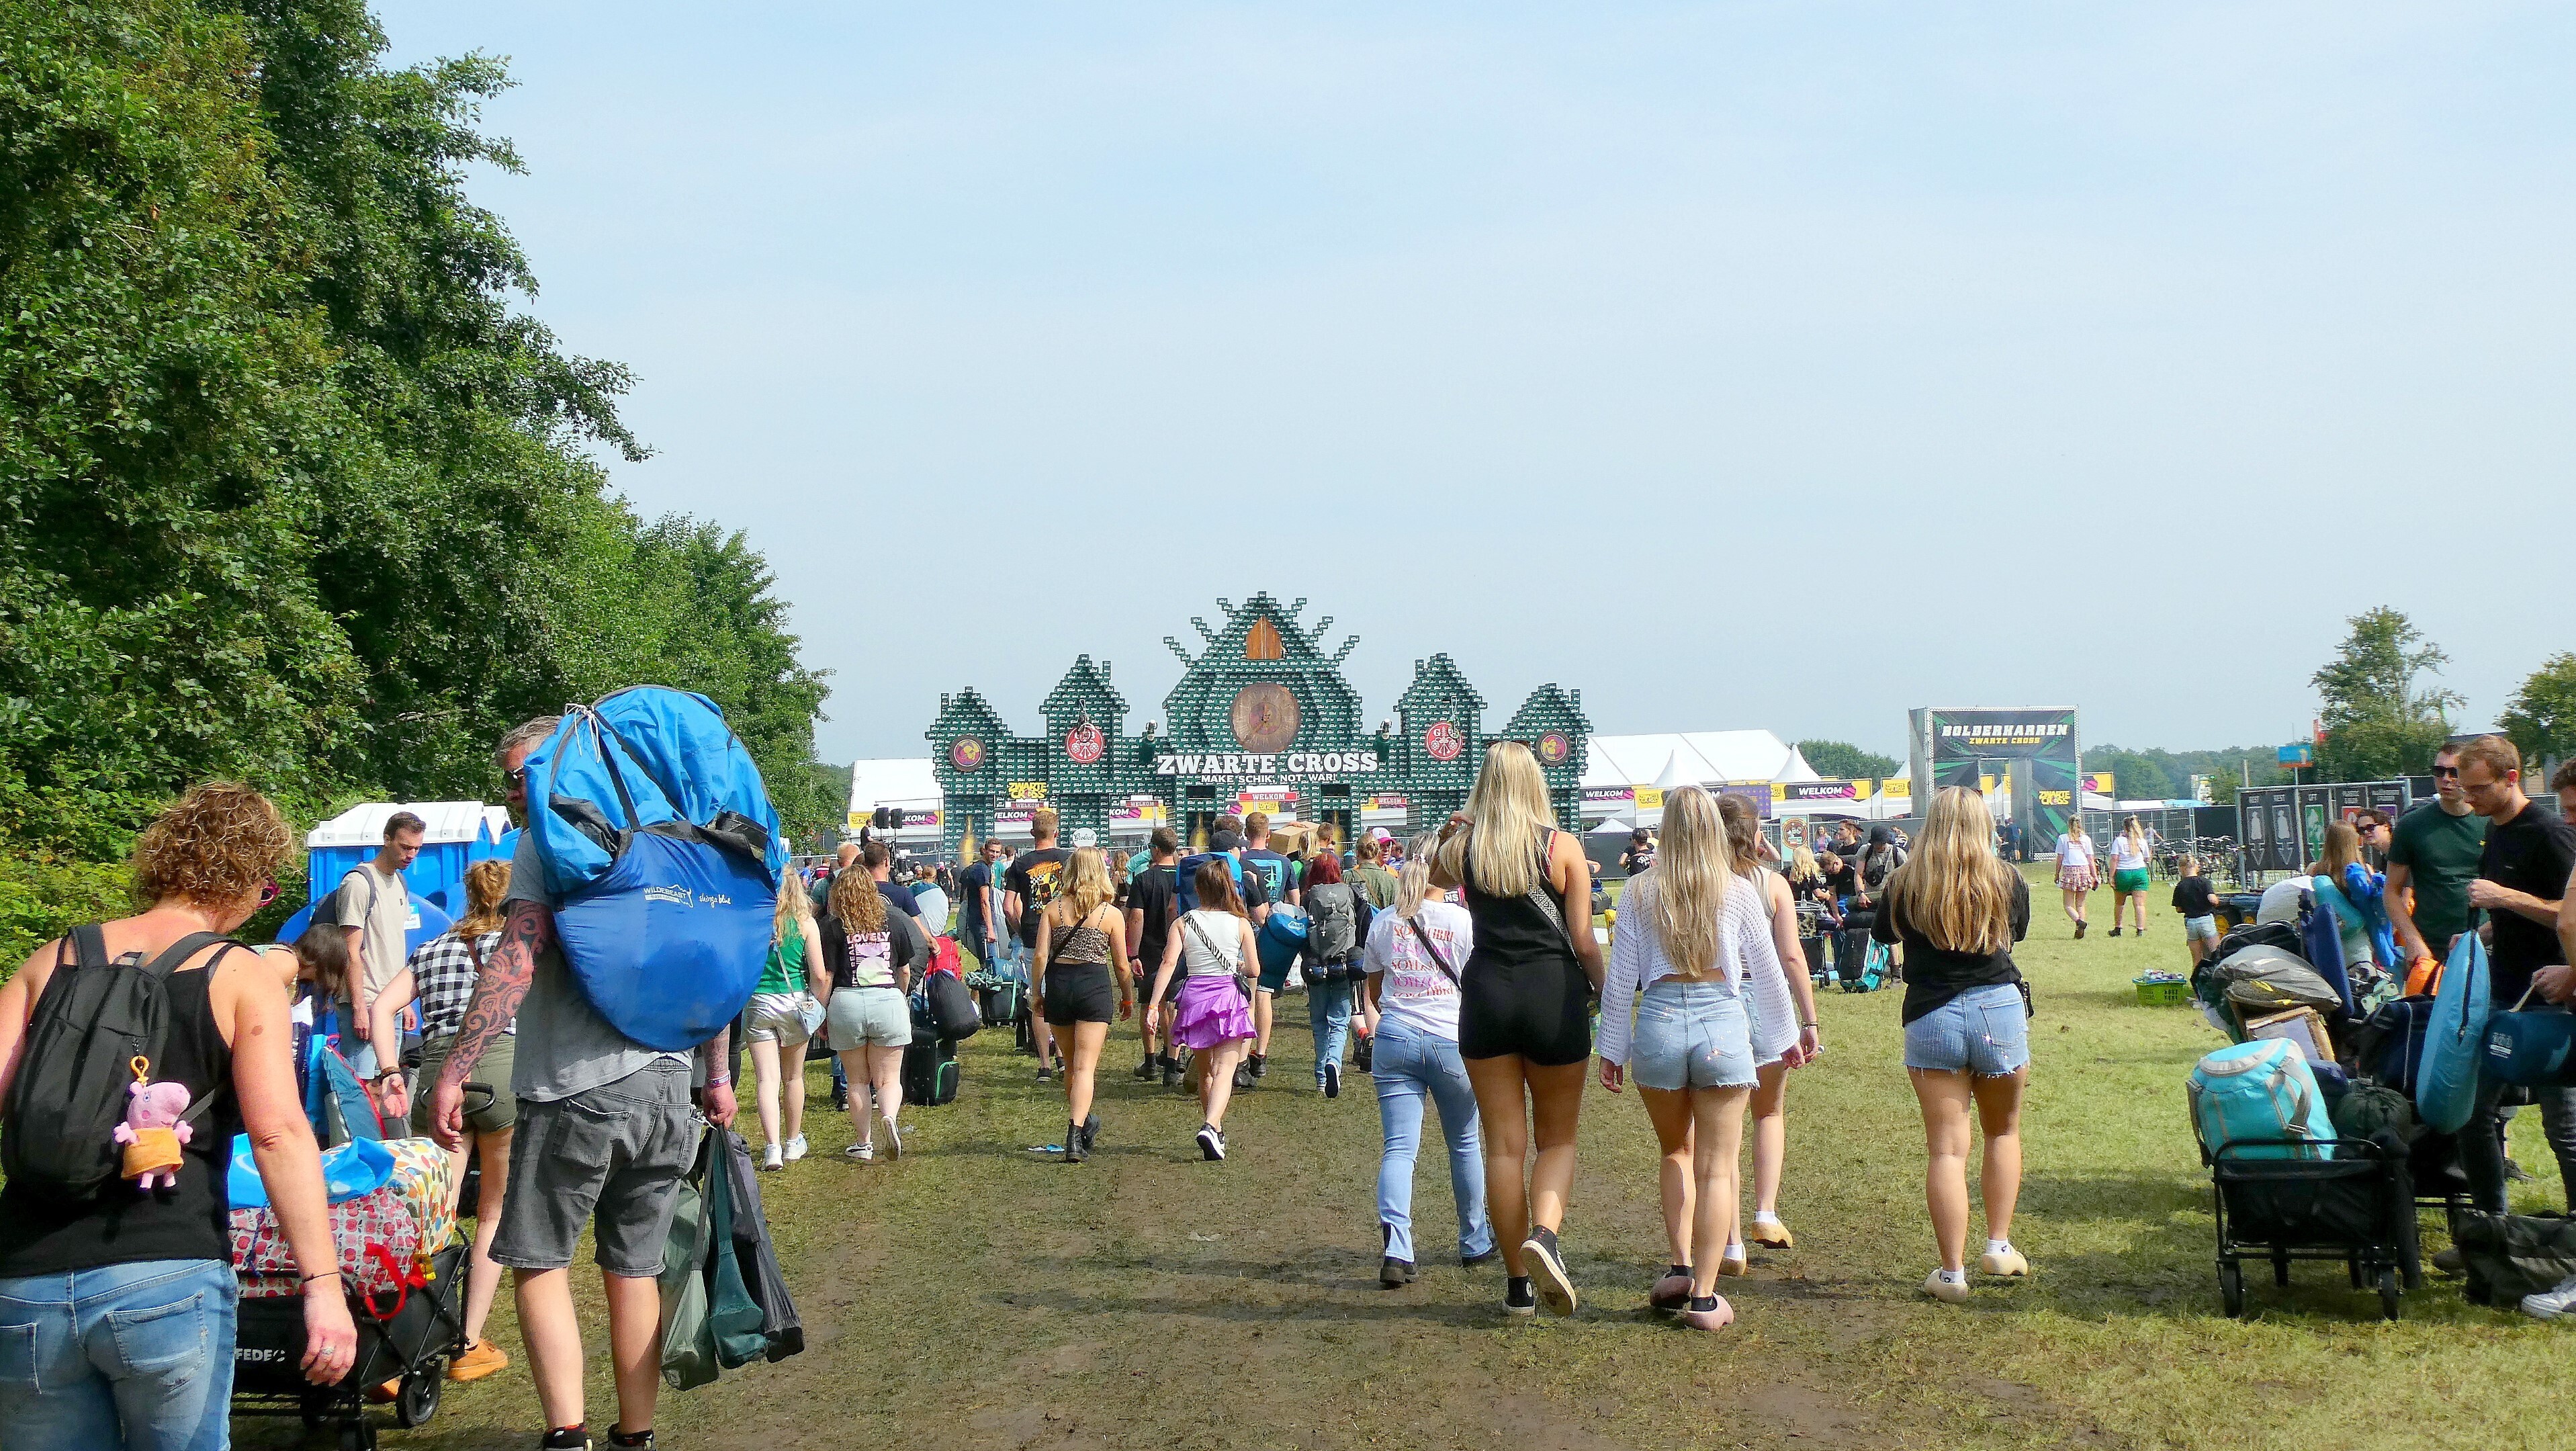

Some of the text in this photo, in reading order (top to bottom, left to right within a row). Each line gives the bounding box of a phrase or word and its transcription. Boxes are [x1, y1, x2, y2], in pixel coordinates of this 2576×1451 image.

[1969, 737, 2008, 745] ZWARTE
[1157, 752, 1378, 774] ZWARTE CROSS
[1201, 773, 1337, 785] MAKE SCHIK, NOT WAR!
[1008, 782, 1048, 793] ZWARTE
[1798, 786, 1843, 795] WELKOM
[1585, 790, 1624, 798] WELKOM
[2039, 790, 2071, 799] ZWARTE
[2041, 797, 2069, 805] CROSS
[902, 814, 926, 822] KOM
[1074, 832, 1095, 842] Grolsch
[643, 886, 686, 899] WILDEBEAST
[1444, 893, 1459, 902] NS
[718, 894, 731, 905] blue
[846, 931, 891, 944] LOVELY
[848, 943, 856, 967] REAL
